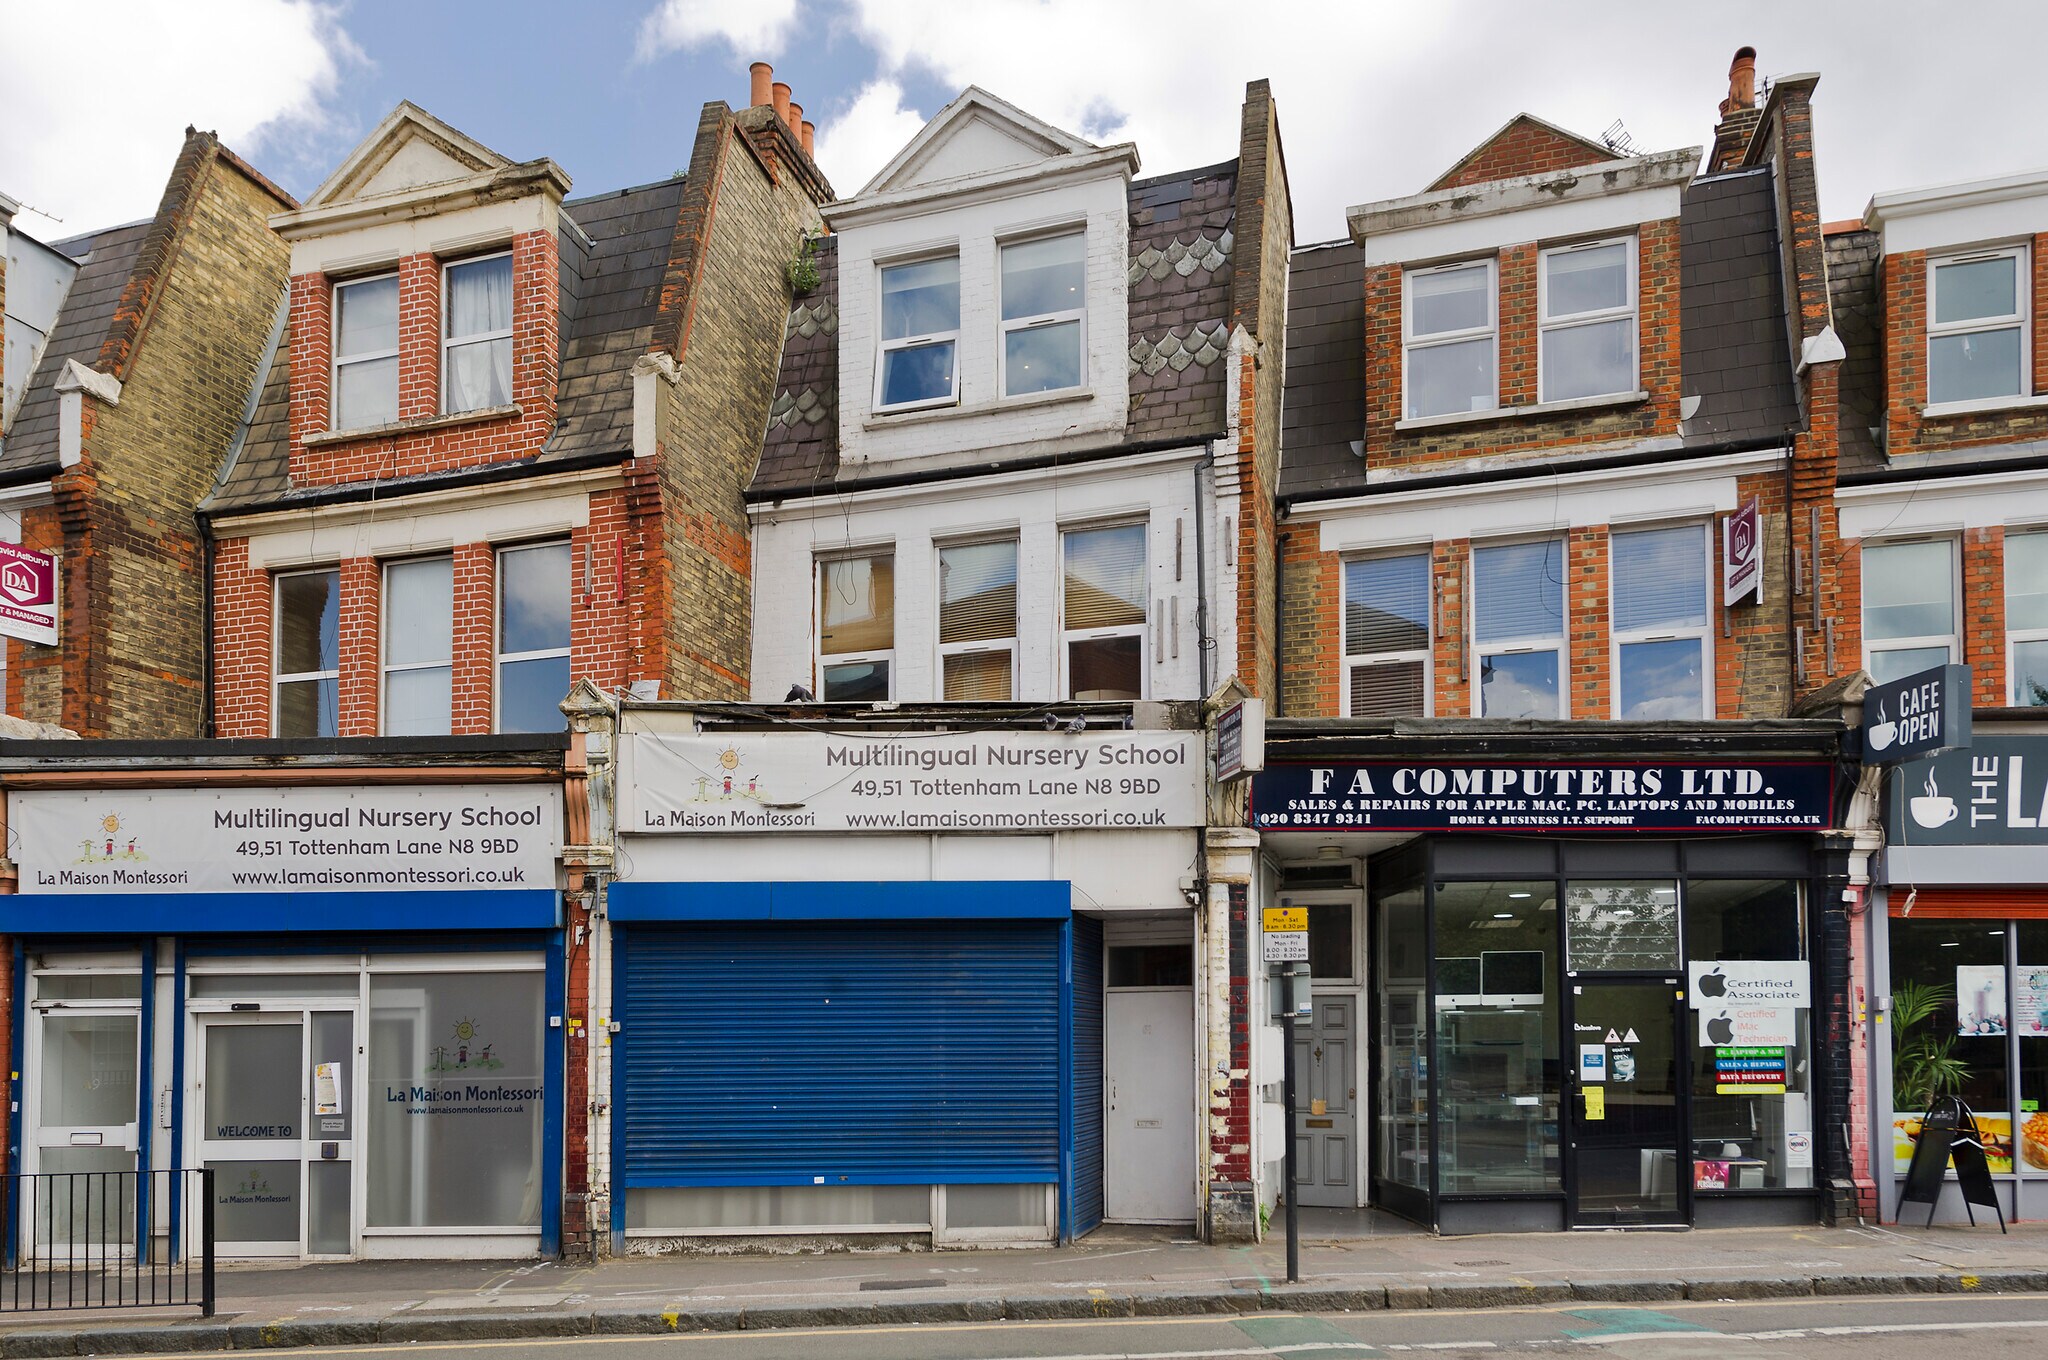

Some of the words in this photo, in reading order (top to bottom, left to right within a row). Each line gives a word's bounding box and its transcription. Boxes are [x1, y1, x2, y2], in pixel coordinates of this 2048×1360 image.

[0, 547, 15, 557] avid
[6, 570, 31, 591] DA
[12, 611, 49, 624] MANAGED
[1900, 681, 1940, 718] CAFE
[1898, 710, 1939, 746] OPEN
[827, 744, 977, 771] Multilingual
[988, 745, 1089, 770] Nursery
[1099, 743, 1186, 765] School
[851, 779, 902, 798] 49,51
[910, 779, 1021, 796] Tottenham
[1029, 780, 1078, 795] Lane
[1086, 779, 1113, 795] N8
[1120, 779, 1161, 795] 9BD
[1310, 769, 1334, 795] F
[1348, 769, 1376, 795] A
[1392, 768, 1662, 796] COMPUTERS
[1679, 769, 1775, 795] LTD.
[1971, 756, 1999, 828] THE
[1288, 799, 1337, 811] SALES
[1342, 799, 1354, 811] &
[1360, 799, 1431, 811] REPAIRS
[1436, 799, 1468, 811] FOR
[1474, 799, 1527, 811] APPLE
[1532, 799, 1571, 812] MAC,
[1607, 799, 1680, 812] LAPTOPS
[1684, 799, 1718, 811] AND
[1723, 799, 1795, 811] MOBILES
[214, 808, 350, 833] Multilingual
[359, 808, 453, 831] Nursery
[461, 806, 541, 827] School
[645, 811, 666, 827] La
[670, 811, 726, 827] Maison
[732, 810, 815, 827] Montessori
[846, 808, 1166, 828] www.lamaisonmontessori.co.uk
[1260, 813, 1288, 824] 020
[1293, 813, 1330, 824] 8347
[1335, 813, 1371, 824] 9341
[1449, 815, 1485, 825] HOME
[1488, 815, 1498, 825] &
[1501, 815, 1560, 825] BUSINESS
[1584, 815, 1635, 825] SUPPORT
[1695, 815, 1821, 825] FACOMPUTERS.CO.UK
[235, 840, 282, 859] 49,51
[289, 839, 390, 856] Tottenham
[397, 839, 443, 855] Lane
[449, 839, 475, 854] N8
[481, 838, 519, 854] 9BD
[37, 870, 55, 886] La
[60, 870, 109, 886] Maison
[113, 868, 188, 885] Montessori
[232, 866, 525, 886] www.lamaisonmontessori.co.uk
[1728, 980, 1793, 988] Certified
[1727, 991, 1800, 999] Associate
[1737, 1009, 1776, 1018] Certified
[1737, 1022, 1758, 1031] iMac
[1737, 1034, 1788, 1043] Technician
[387, 1087, 406, 1102] La
[410, 1086, 461, 1102] Maison
[465, 1086, 543, 1101] Montessori
[406, 1105, 524, 1115] www.lamaisonmontessori.co.uk
[218, 1126, 275, 1137] WELCOME
[278, 1126, 292, 1137] TO
[255, 1195, 291, 1203] Montessori
